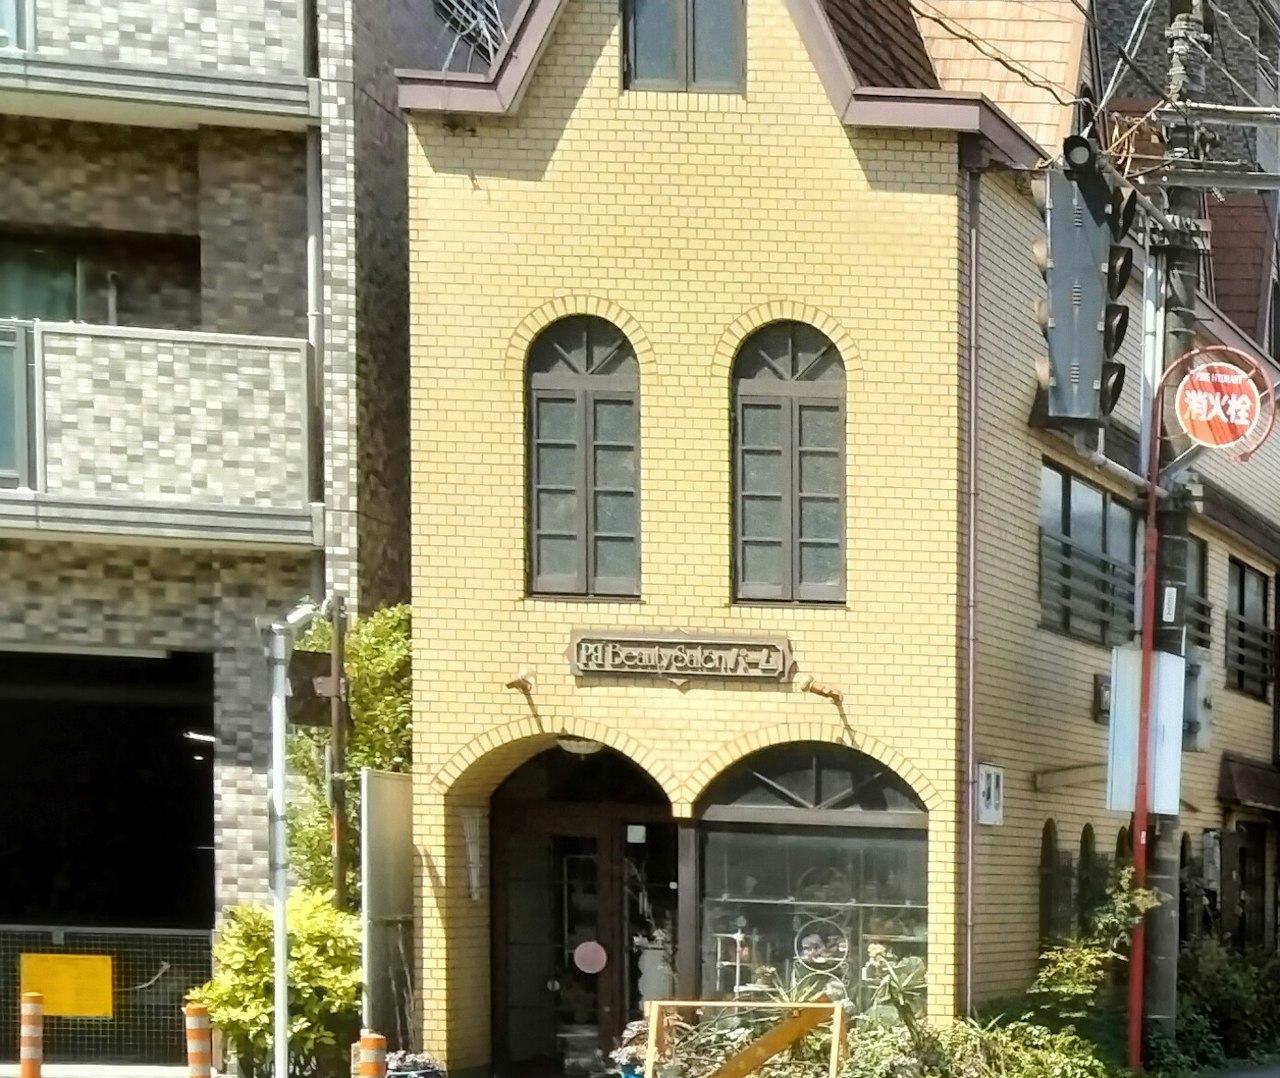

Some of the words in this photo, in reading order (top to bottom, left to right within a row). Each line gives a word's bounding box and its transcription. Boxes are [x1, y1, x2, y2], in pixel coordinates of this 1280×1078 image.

[1183, 389, 1251, 425] 消火栓
[608, 643, 673, 674] Beauty
[673, 645, 725, 668] Salon
